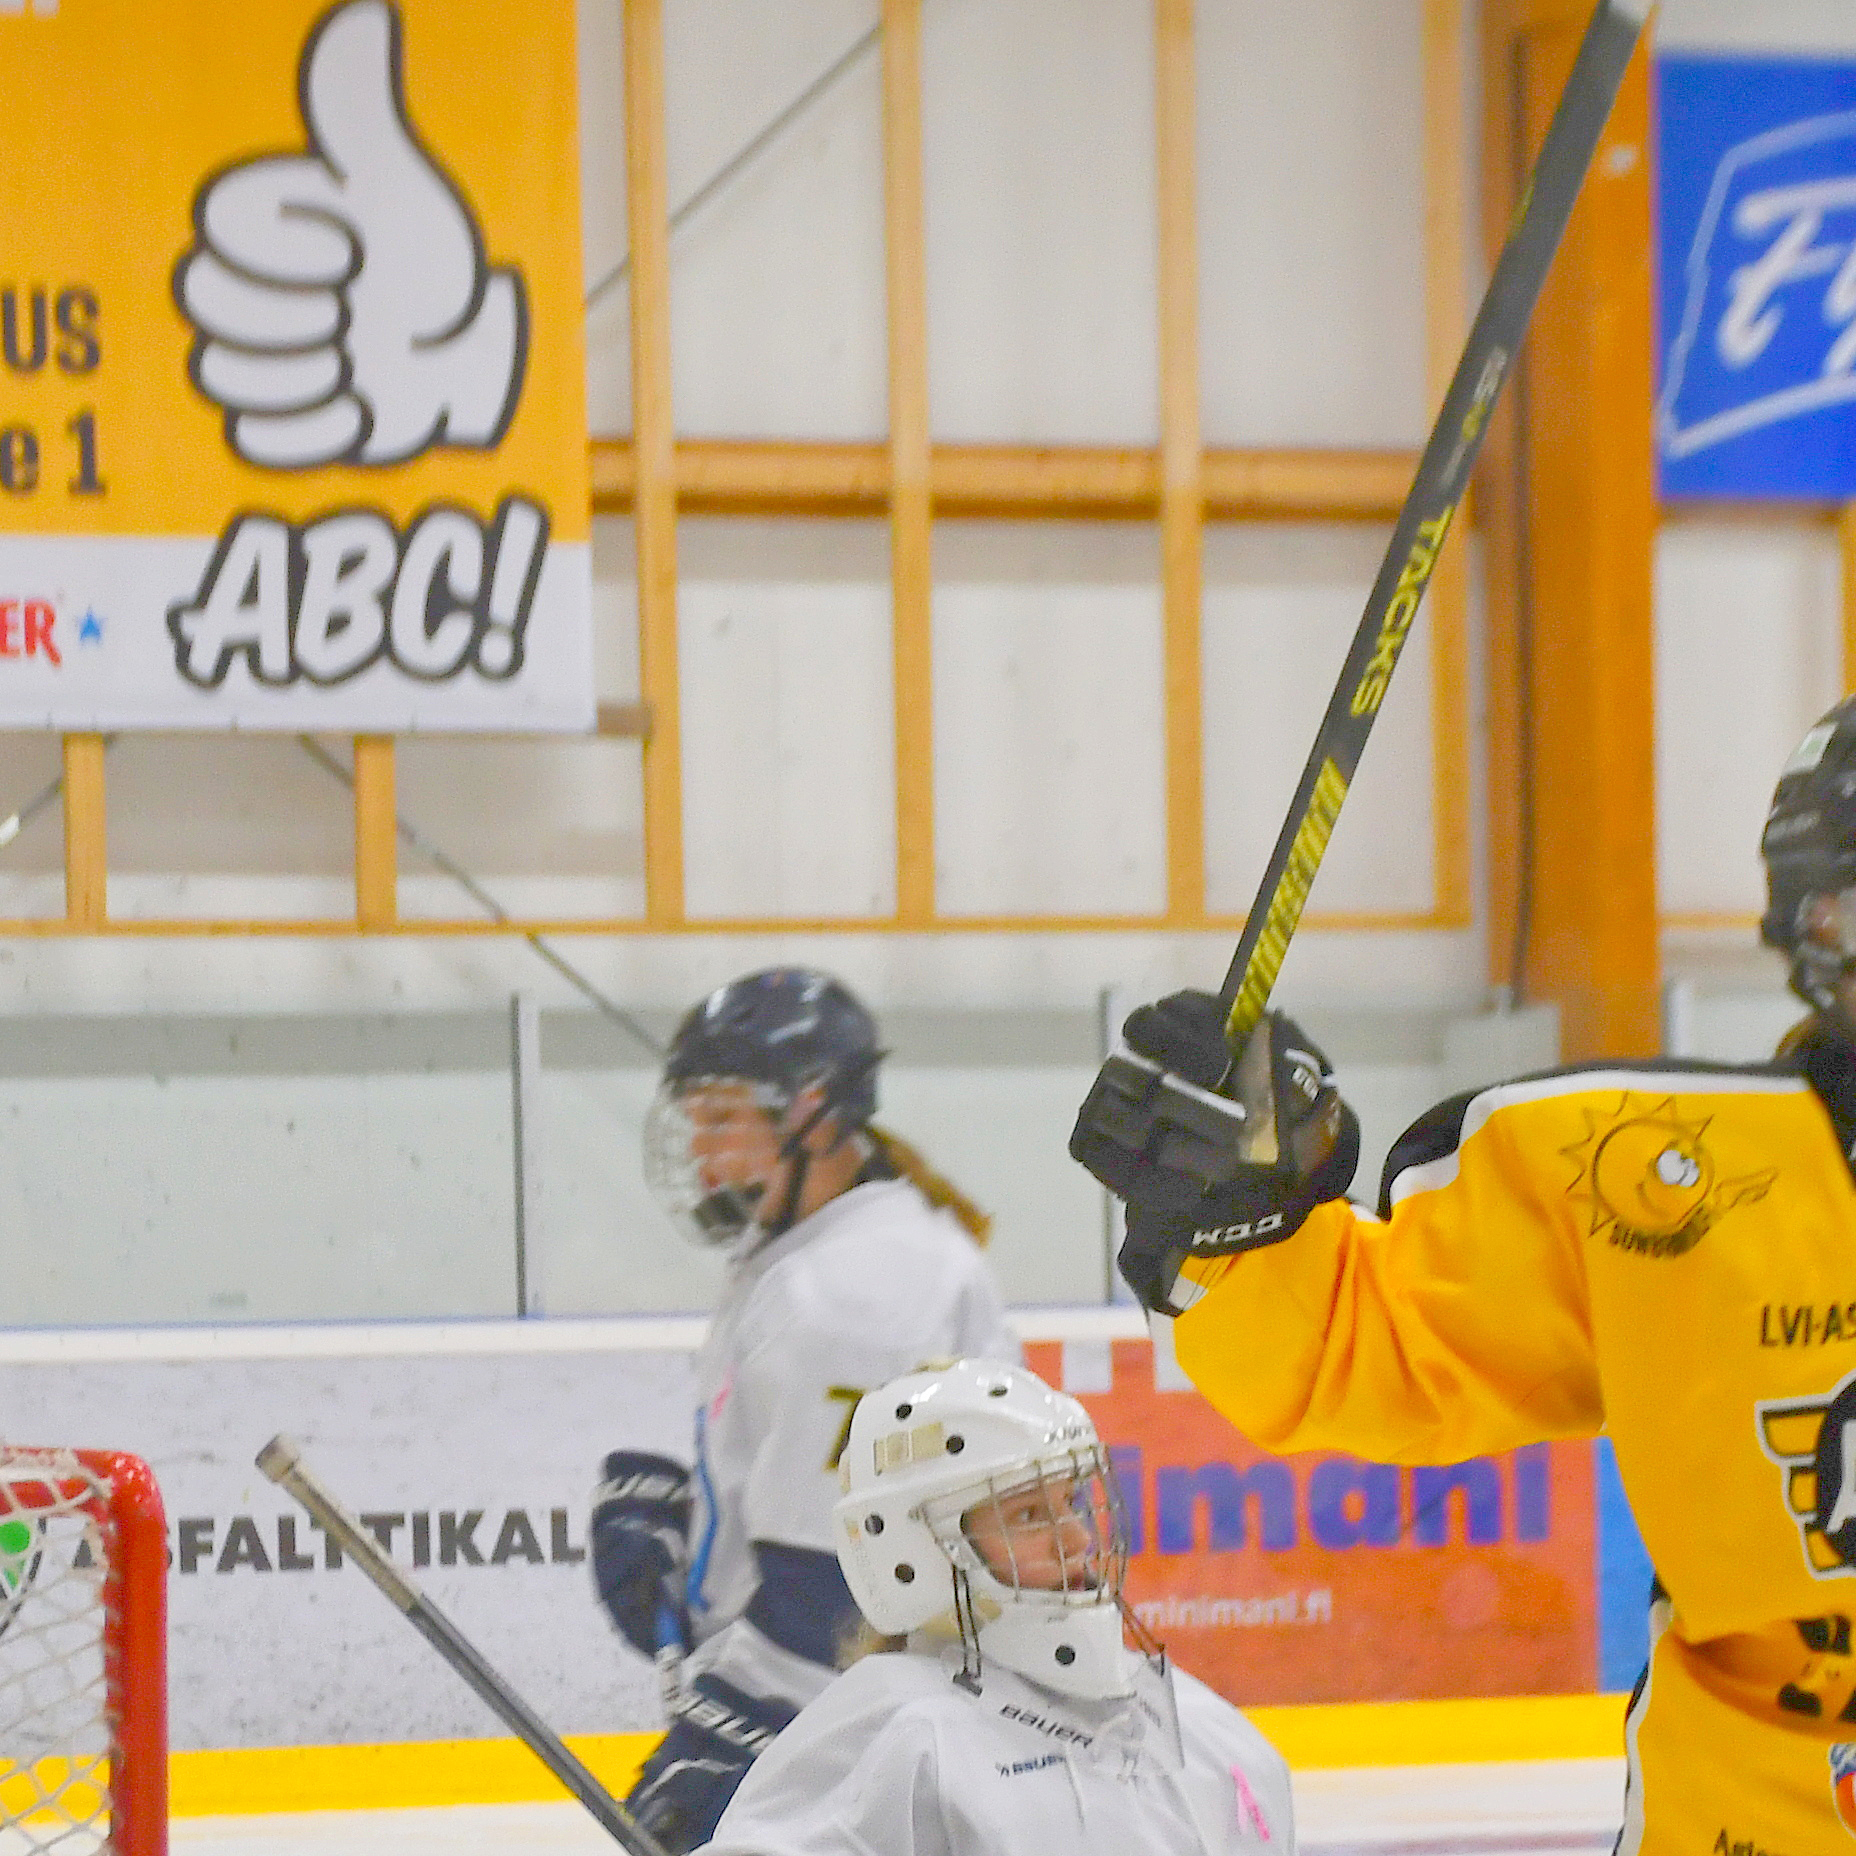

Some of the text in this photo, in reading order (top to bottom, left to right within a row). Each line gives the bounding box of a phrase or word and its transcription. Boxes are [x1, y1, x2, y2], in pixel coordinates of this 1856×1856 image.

[66, 416, 109, 497] 1
[170, 494, 548, 690] ABC!
[1349, 502, 1455, 718] TACKS
[1192, 1212, 1286, 1248] CCM
[72, 1507, 587, 1577] FALTTIKAL
[1110, 1441, 1551, 1556] imani
